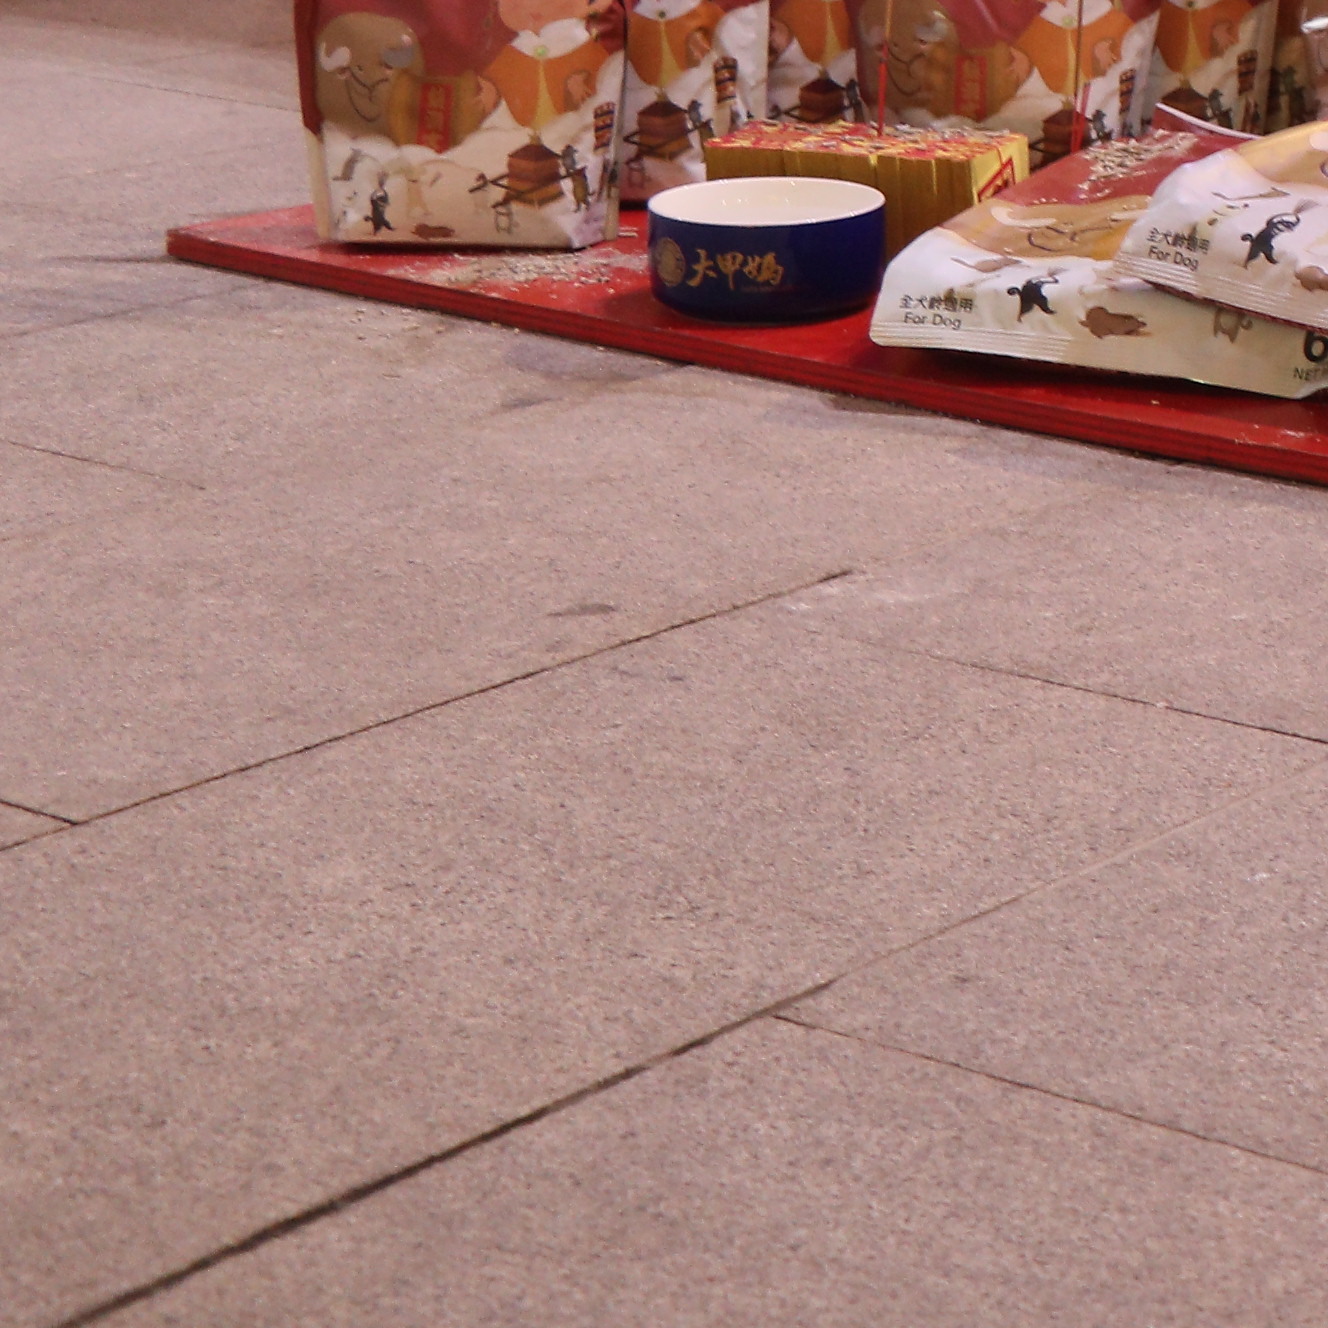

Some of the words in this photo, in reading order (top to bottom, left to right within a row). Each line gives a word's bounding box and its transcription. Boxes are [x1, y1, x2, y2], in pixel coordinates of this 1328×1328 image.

[686, 248, 785, 291] 大甲媽
[1148, 245, 1170, 260] For
[1173, 251, 1199, 272] Dog
[903, 311, 927, 325] For
[932, 313, 962, 331] Dog
